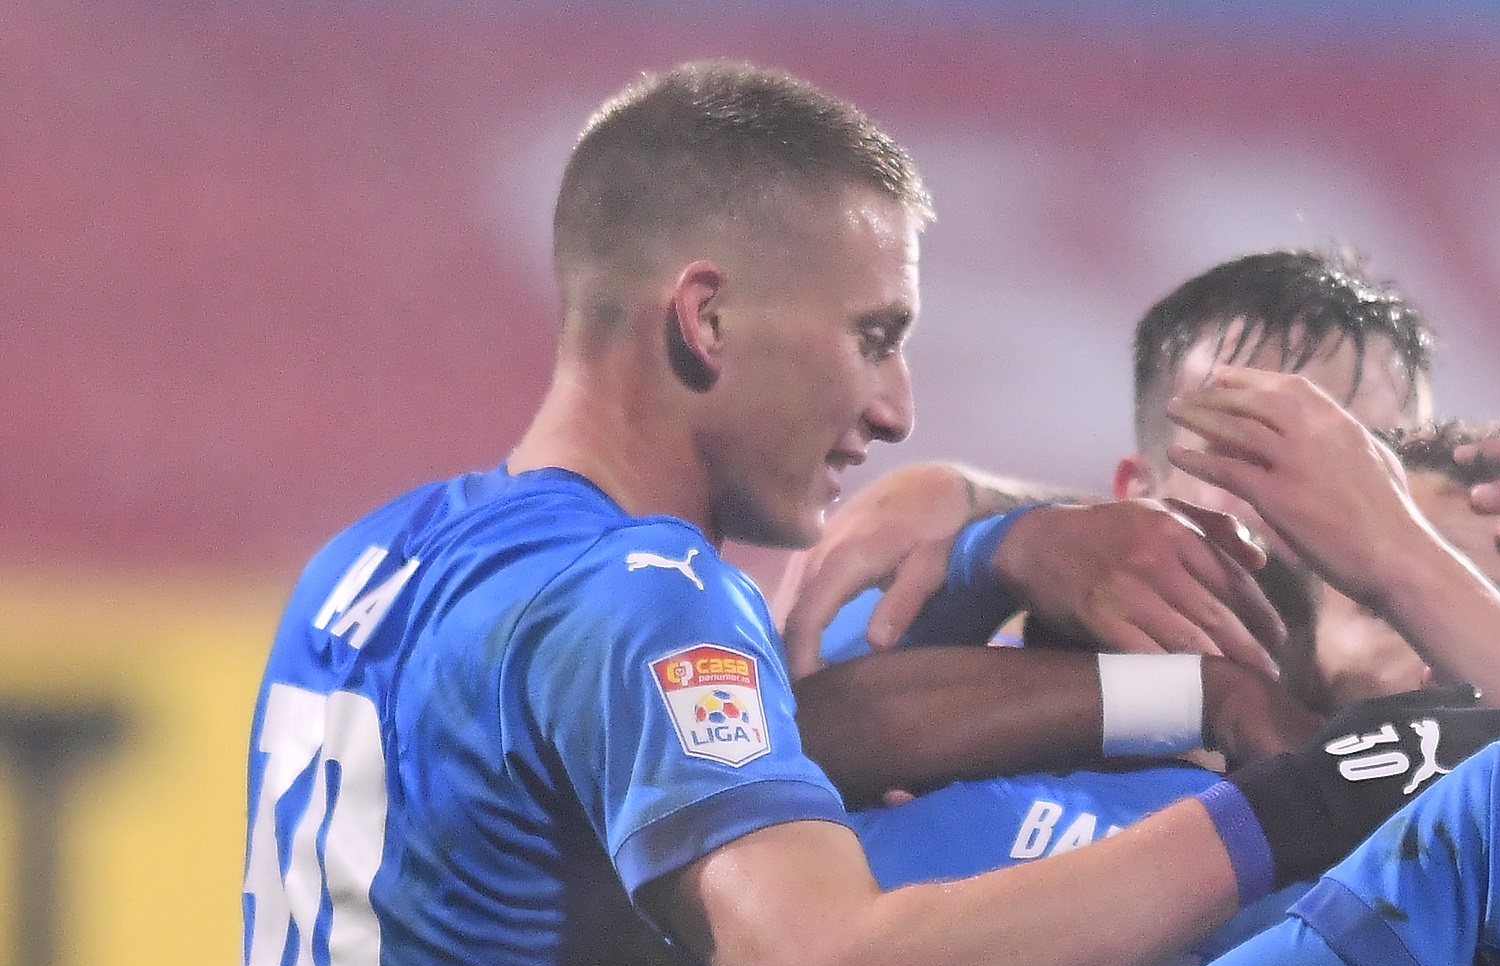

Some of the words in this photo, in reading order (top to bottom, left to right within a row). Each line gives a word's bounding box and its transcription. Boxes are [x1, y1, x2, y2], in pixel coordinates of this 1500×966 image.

[690, 726, 750, 745] LIGA
[752, 728, 762, 743] 1
[1009, 800, 1122, 859] BA
